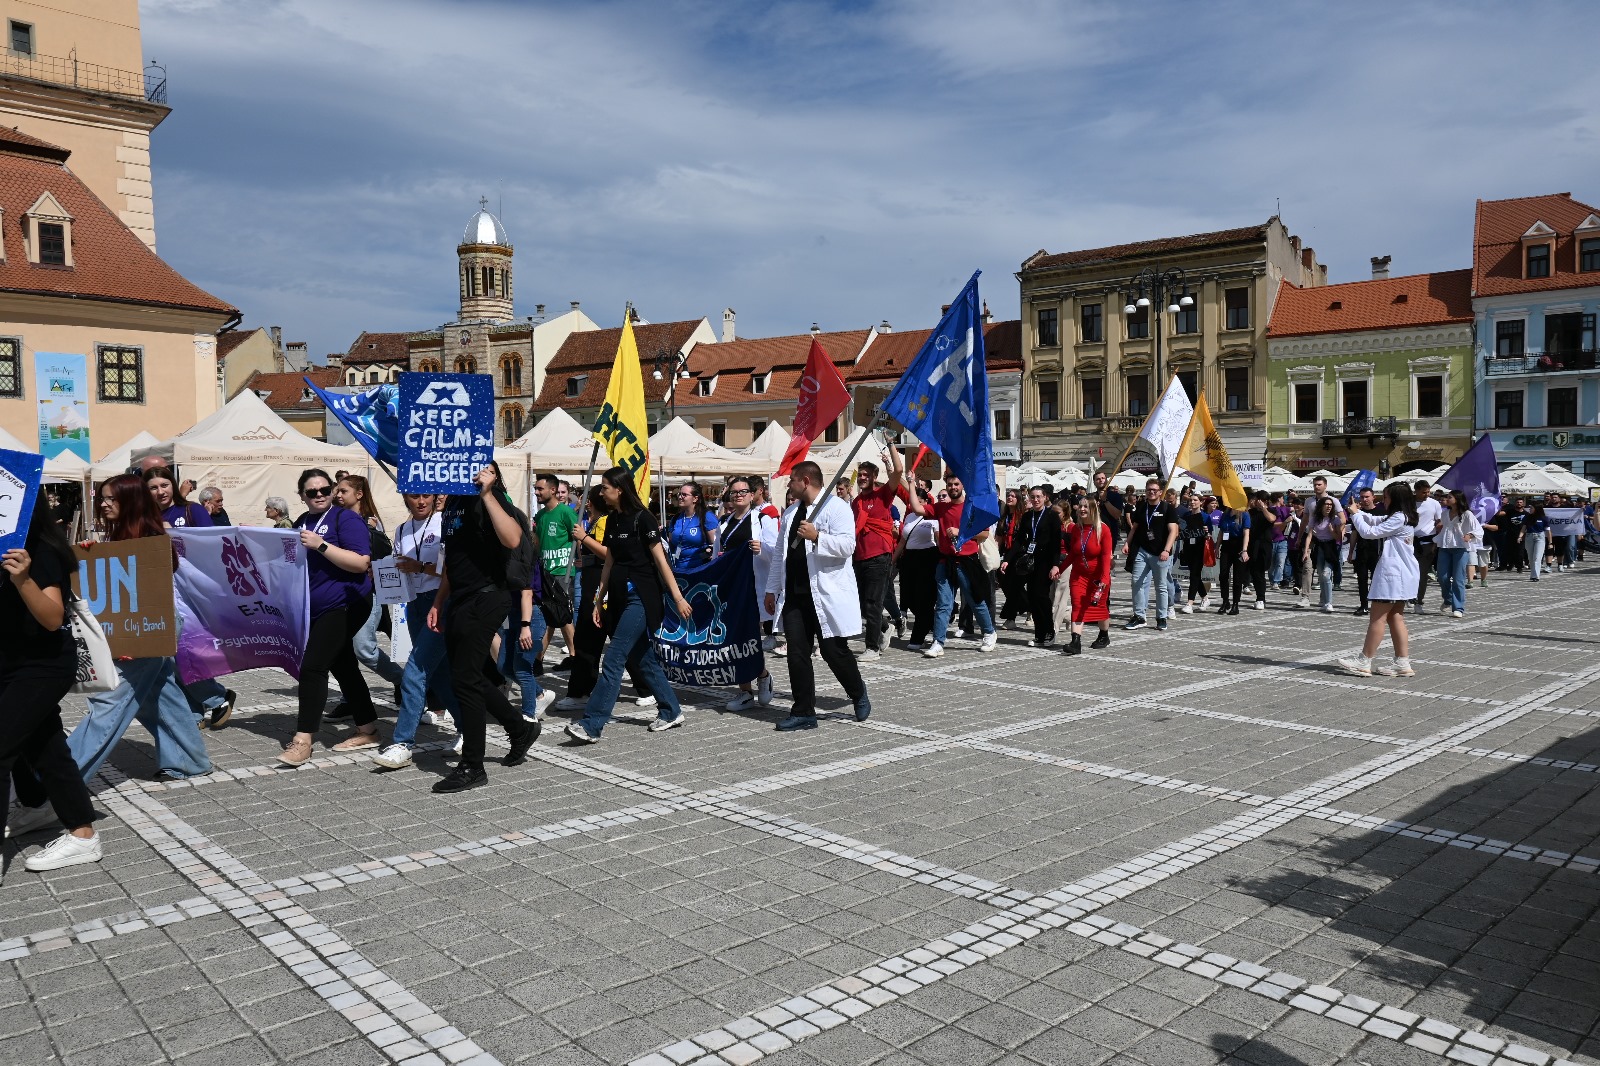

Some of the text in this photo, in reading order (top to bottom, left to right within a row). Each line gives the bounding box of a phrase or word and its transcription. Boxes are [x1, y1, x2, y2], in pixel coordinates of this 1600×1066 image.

[410, 408, 468, 427] KEEP
[404, 428, 472, 448] CALM
[1513, 434, 1548, 446] CEC
[421, 449, 487, 461] become an
[237, 600, 285, 620] E-Team
[124, 618, 140, 637] Cluj
[143, 615, 166, 632] Branch
[212, 633, 281, 650] Psychology
